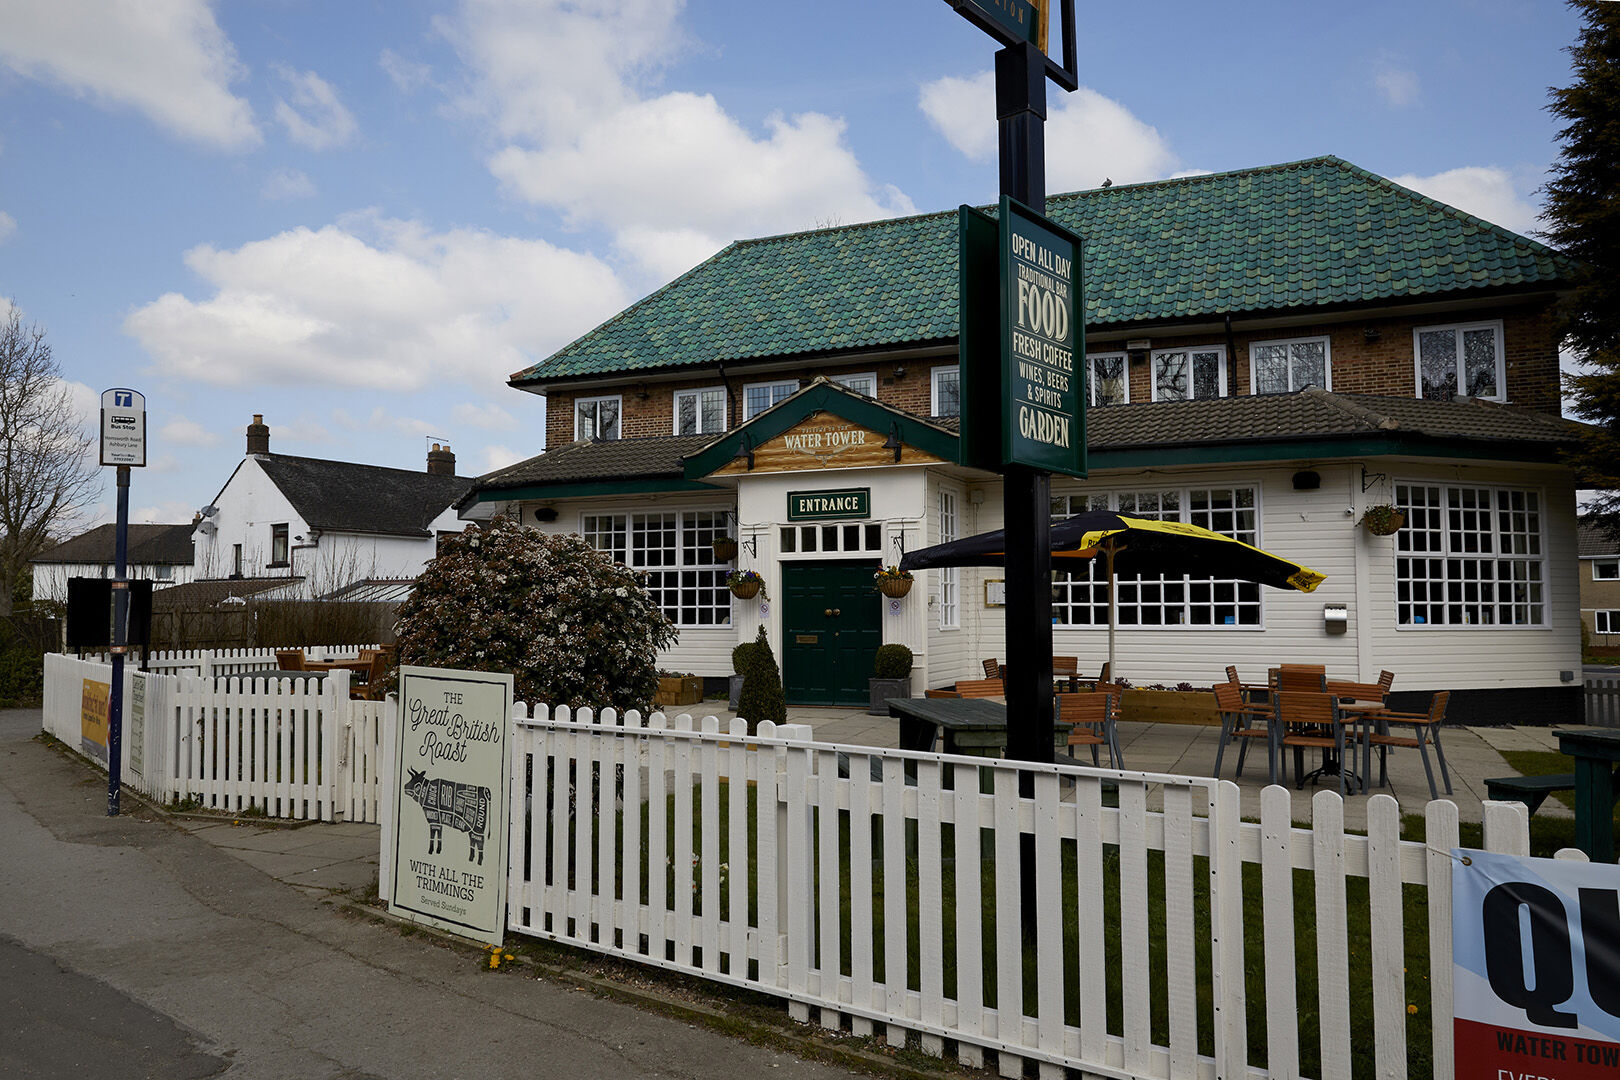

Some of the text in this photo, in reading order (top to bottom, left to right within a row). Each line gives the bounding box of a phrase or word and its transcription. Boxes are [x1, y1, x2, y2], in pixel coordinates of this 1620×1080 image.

[1012, 232, 1071, 279] OPEN ALL DAY
[1017, 263, 1068, 299] TRADITIONAL BAR
[1017, 277, 1069, 342] FOOD
[1013, 331, 1073, 371] FRESH COFFEE
[1018, 361, 1069, 392] WINES, BEERS
[1027, 383, 1062, 409] & SPIRITS
[784, 430, 866, 449] WATER TOWER
[1019, 405, 1070, 449] GARDEN
[799, 496, 859, 512] ENTRANCE
[443, 691, 463, 704] THE
[409, 697, 500, 743] Great British
[419, 731, 467, 766] Roast
[428, 785, 438, 806] CHUCK
[441, 784, 453, 808] RIB
[476, 798, 486, 829] ROUND
[409, 859, 484, 889] WITH ALL THE
[416, 875, 474, 902] TRIMMINGS
[420, 895, 467, 916] Served Sundays
[1496, 1031, 1566, 1061] WATER
